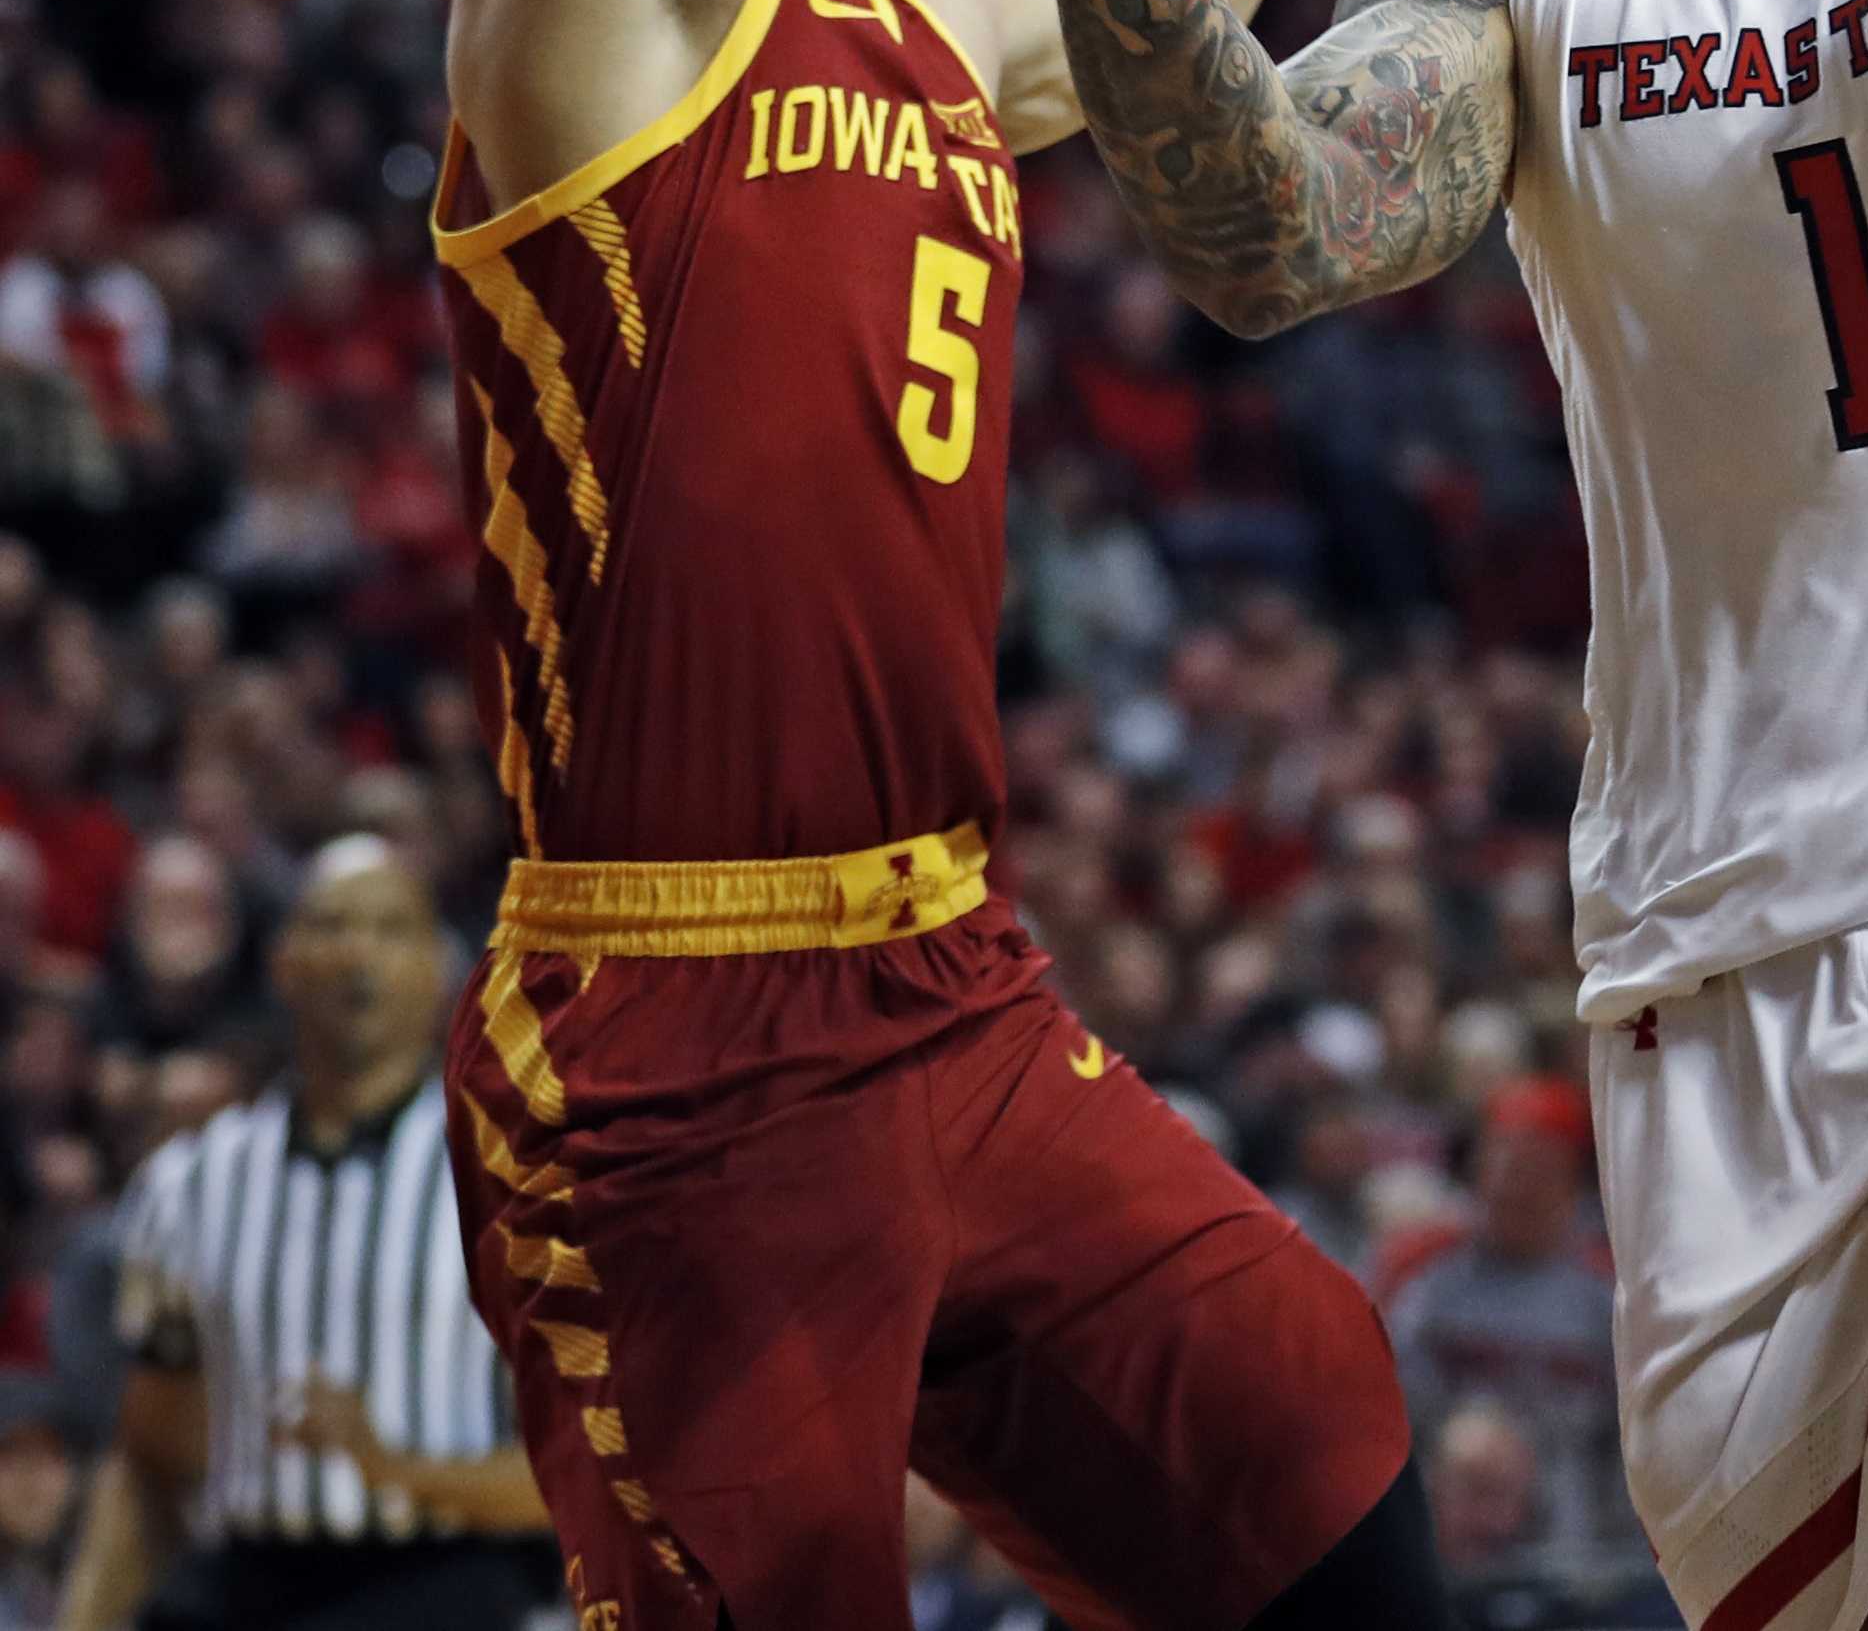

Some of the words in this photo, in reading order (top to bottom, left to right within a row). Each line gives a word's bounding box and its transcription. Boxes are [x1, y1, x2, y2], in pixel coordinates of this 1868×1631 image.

[1568, 26, 1821, 129] TEXAS
[744, 84, 939, 190] IOWA
[897, 234, 992, 485] 5
